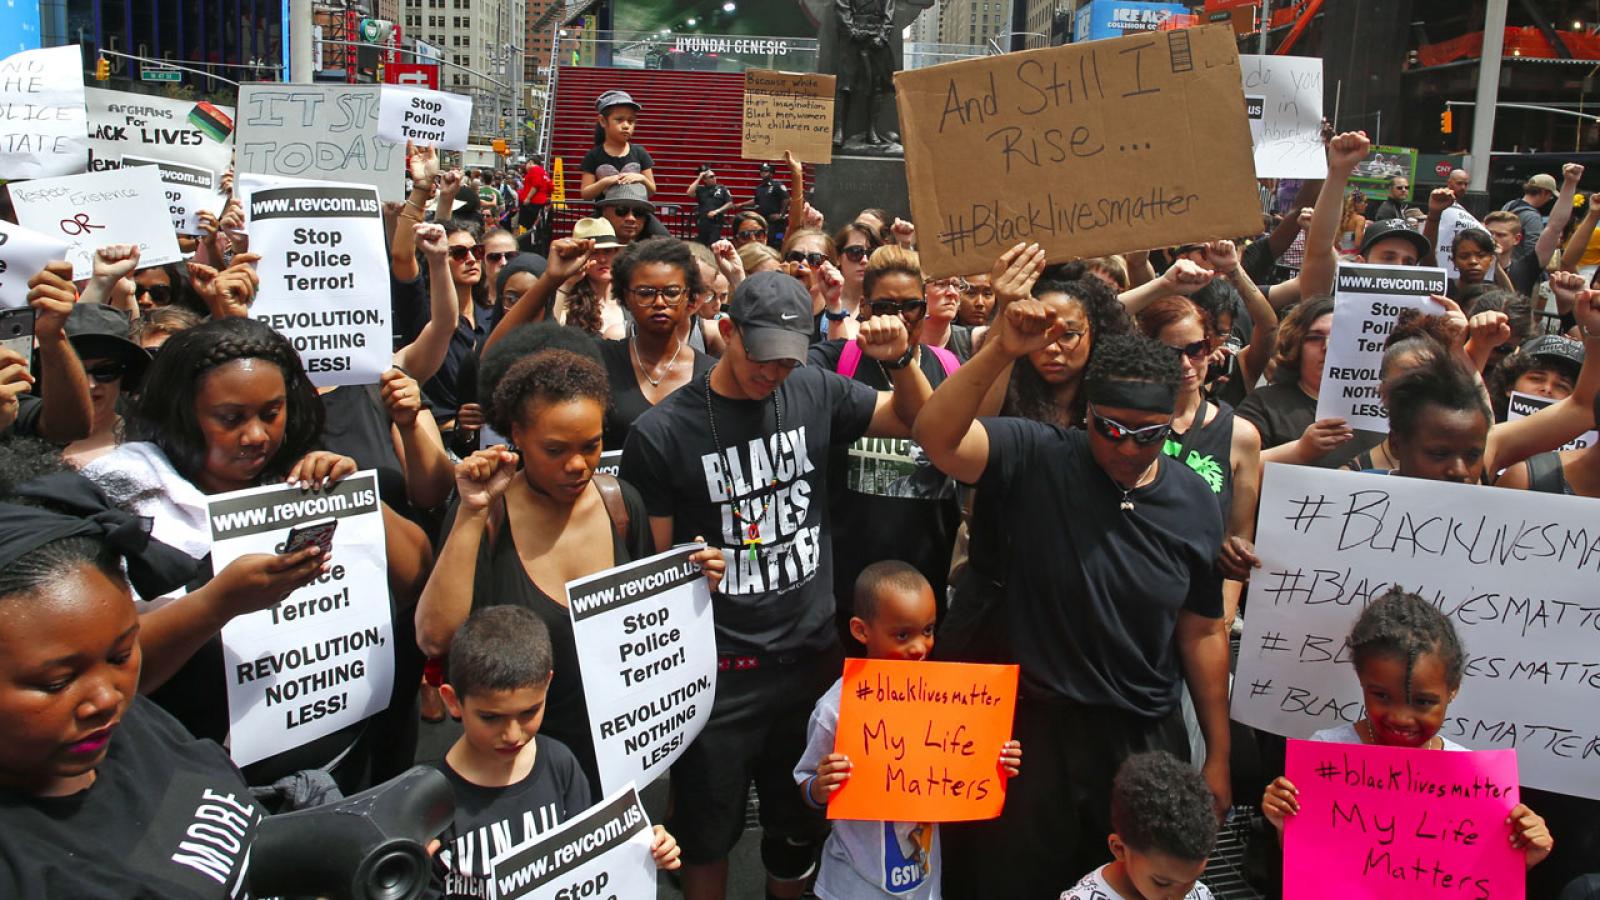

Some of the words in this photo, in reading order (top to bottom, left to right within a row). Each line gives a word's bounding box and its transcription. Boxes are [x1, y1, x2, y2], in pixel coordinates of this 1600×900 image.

[675, 37, 731, 54] HYUNDAI
[734, 39, 788, 56] GENESIS
[4, 77, 43, 93] HE
[939, 70, 998, 133] And
[1017, 49, 1105, 116] Still
[1118, 41, 1161, 98] I
[108, 103, 174, 120] AFGHANS
[247, 93, 326, 127] IT
[411, 97, 443, 113] Stop
[746, 107, 772, 119] Black
[126, 115, 149, 127] For
[404, 110, 446, 128] Police
[767, 119, 810, 131] children
[3, 133, 71, 154] TATE
[87, 121, 129, 141] LACK
[141, 128, 203, 146] LIVES
[401, 124, 446, 142] Terror!
[244, 134, 398, 176] TODAY
[14, 181, 71, 203] Respect
[164, 190, 182, 202] op
[252, 198, 378, 215] www.revcom.us
[60, 213, 106, 236] OR
[293, 228, 342, 248] Stop
[286, 250, 352, 268] Police
[284, 272, 355, 291] Terror!
[1340, 275, 1444, 292] www.revcom.us
[1362, 320, 1395, 335] Poli
[290, 332, 366, 351] OTHING
[306, 356, 351, 373] ESS!
[1342, 385, 1382, 399] NOTH
[1351, 403, 1389, 419] LESS
[700, 425, 816, 504] BLACK
[213, 488, 375, 531] www.revcom.us
[720, 478, 812, 546] LIVES
[573, 557, 702, 614] www.revcom.us
[269, 587, 350, 625] Terror!
[623, 606, 670, 635] Stop
[236, 627, 386, 686] REVOLUTION,
[619, 627, 681, 663] Police
[620, 647, 686, 688] Terror!
[265, 659, 365, 707] NOTHING
[286, 692, 348, 730] LESS!
[600, 675, 712, 740] REVOLUTION,
[624, 704, 697, 755] NOTHING
[863, 719, 905, 761] My
[925, 720, 976, 757] Life
[642, 731, 685, 771] LESS!
[886, 761, 991, 801] Matters
[171, 788, 255, 884] MORE
[1332, 801, 1396, 846] My
[1415, 811, 1480, 845] Life
[498, 804, 642, 896] www.revcom.us
[554, 871, 609, 900] Stop
[1363, 848, 1491, 900] Matters
